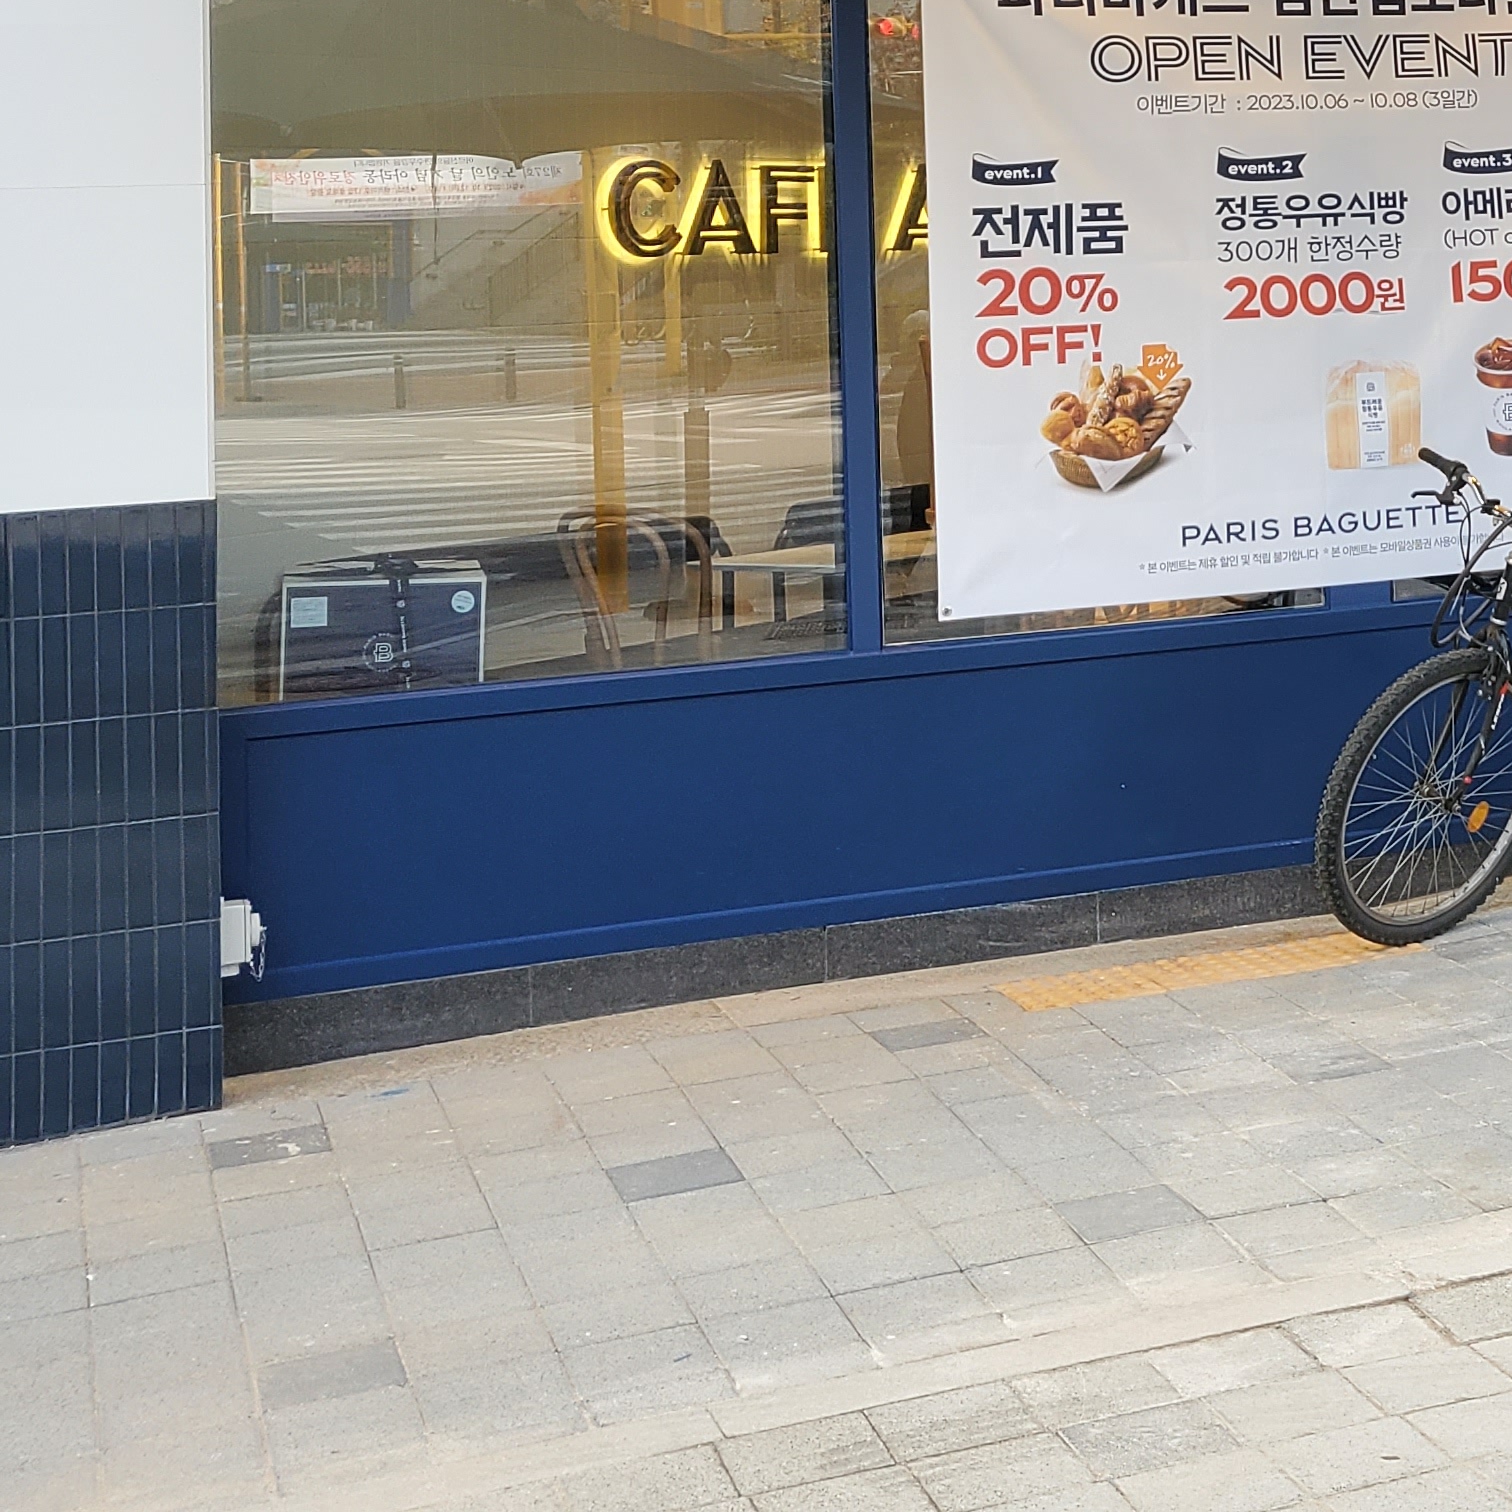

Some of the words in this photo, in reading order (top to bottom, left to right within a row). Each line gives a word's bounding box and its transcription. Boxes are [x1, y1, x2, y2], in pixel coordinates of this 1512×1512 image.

[1089, 33, 1283, 83] OPEN
[1135, 93, 1227, 116] 이벤트기간
[1246, 93, 1350, 112] 2023.10.06
[1368, 91, 1419, 109] 10.08
[1421, 88, 1479, 110] (3일간)
[983, 165, 1043, 180] event.1
[1227, 159, 1294, 176] event.2
[1452, 152, 1512, 169] event.3
[607, 158, 828, 258] CAF
[1214, 190, 1409, 232] 정통우유식빵
[970, 201, 1130, 260] 전제품
[1216, 236, 1299, 264] 300개
[1306, 232, 1403, 263] 한정수량
[1443, 226, 1500, 250] (HOT
[974, 266, 1119, 319] 20%
[1222, 270, 1406, 321] 2000원
[975, 322, 1103, 369] OFF!
[1146, 352, 1176, 369] 20%
[1181, 518, 1281, 548] PARIS
[1293, 503, 1464, 538] BAGUETTE
[1147, 562, 1158, 575] 본
[1159, 558, 1198, 573] 이벤트는
[1198, 557, 1218, 570] 제휴
[1219, 555, 1239, 569] 할인
[1240, 553, 1251, 567] 및
[1252, 551, 1272, 565] 적립
[1331, 546, 1341, 559] 본
[1342, 543, 1379, 557] 이벤트는
[1379, 537, 1432, 554] 모바일상품권
